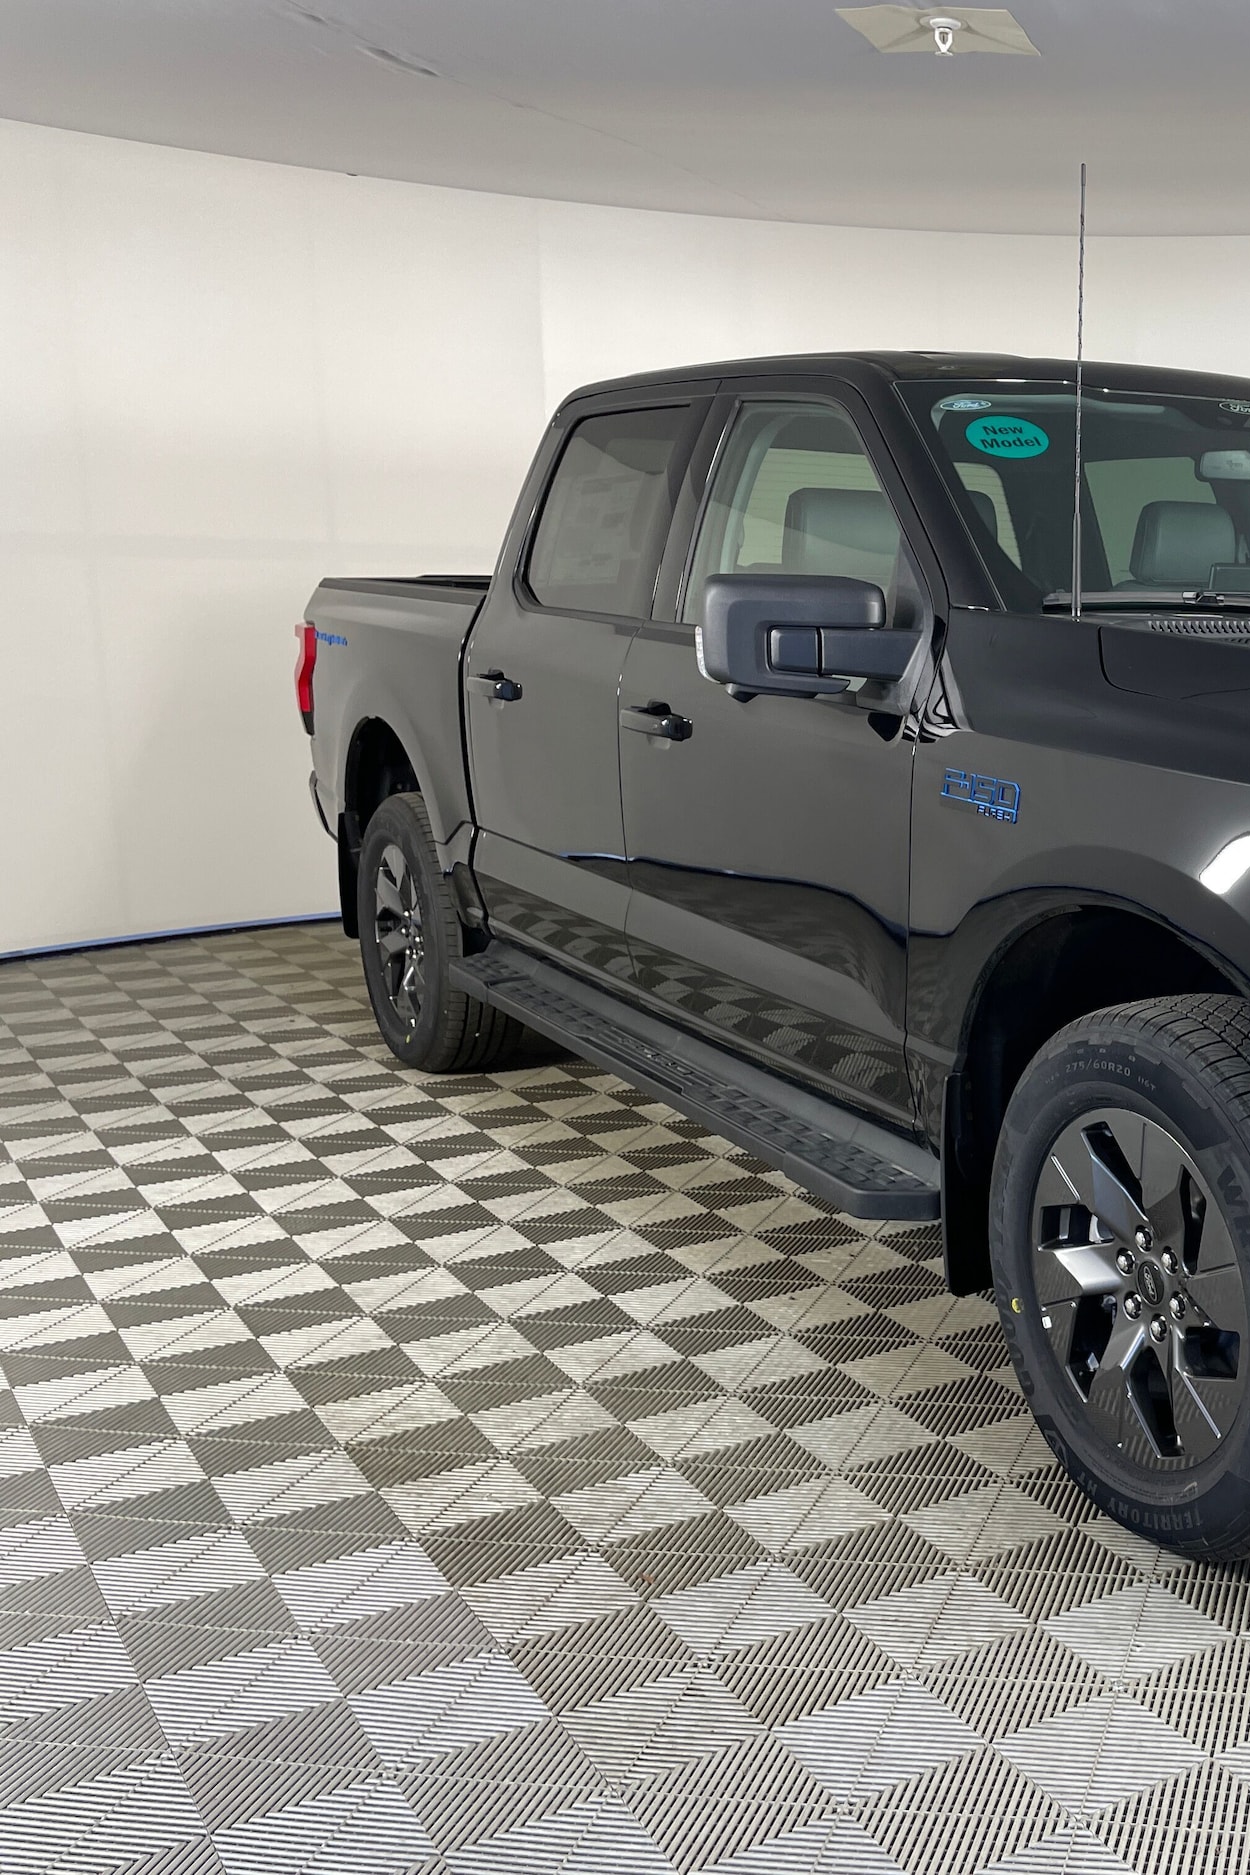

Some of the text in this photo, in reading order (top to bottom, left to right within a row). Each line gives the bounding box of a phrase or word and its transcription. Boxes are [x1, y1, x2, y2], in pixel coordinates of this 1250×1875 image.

[982, 425, 1024, 436] New
[980, 436, 1043, 449] Model
[1065, 1058, 1131, 1077] 275/60R20
[1106, 1496, 1203, 1530] TERRITORY
